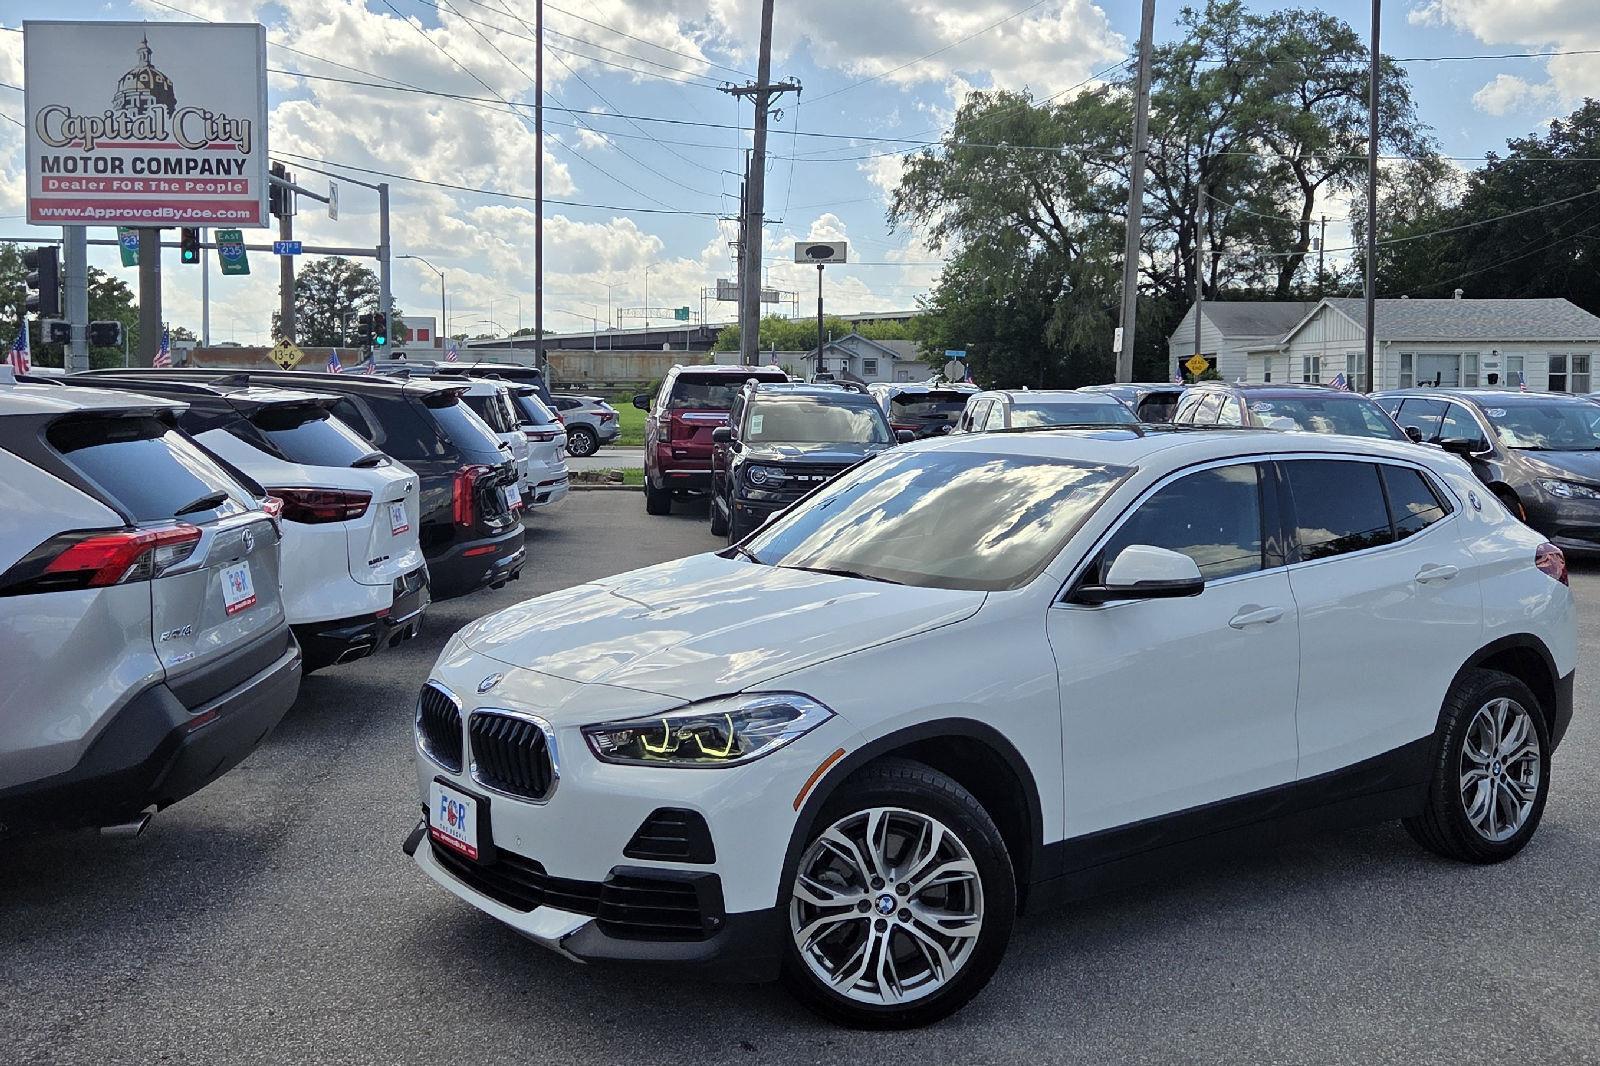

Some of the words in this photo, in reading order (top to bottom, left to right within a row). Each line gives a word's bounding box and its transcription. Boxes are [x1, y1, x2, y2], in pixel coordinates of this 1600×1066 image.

[35, 104, 169, 152] Capital
[172, 106, 252, 154] City
[41, 155, 125, 174] MOTOR
[131, 157, 247, 176] COMPANY
[48, 179, 106, 190] Dealer
[113, 181, 144, 191] FOR
[149, 181, 180, 191] The
[185, 181, 243, 193] People
[39, 206, 250, 220] www.ApprovedByJoe.com
[218, 232, 240, 240] EAST
[222, 247, 242, 256] 235
